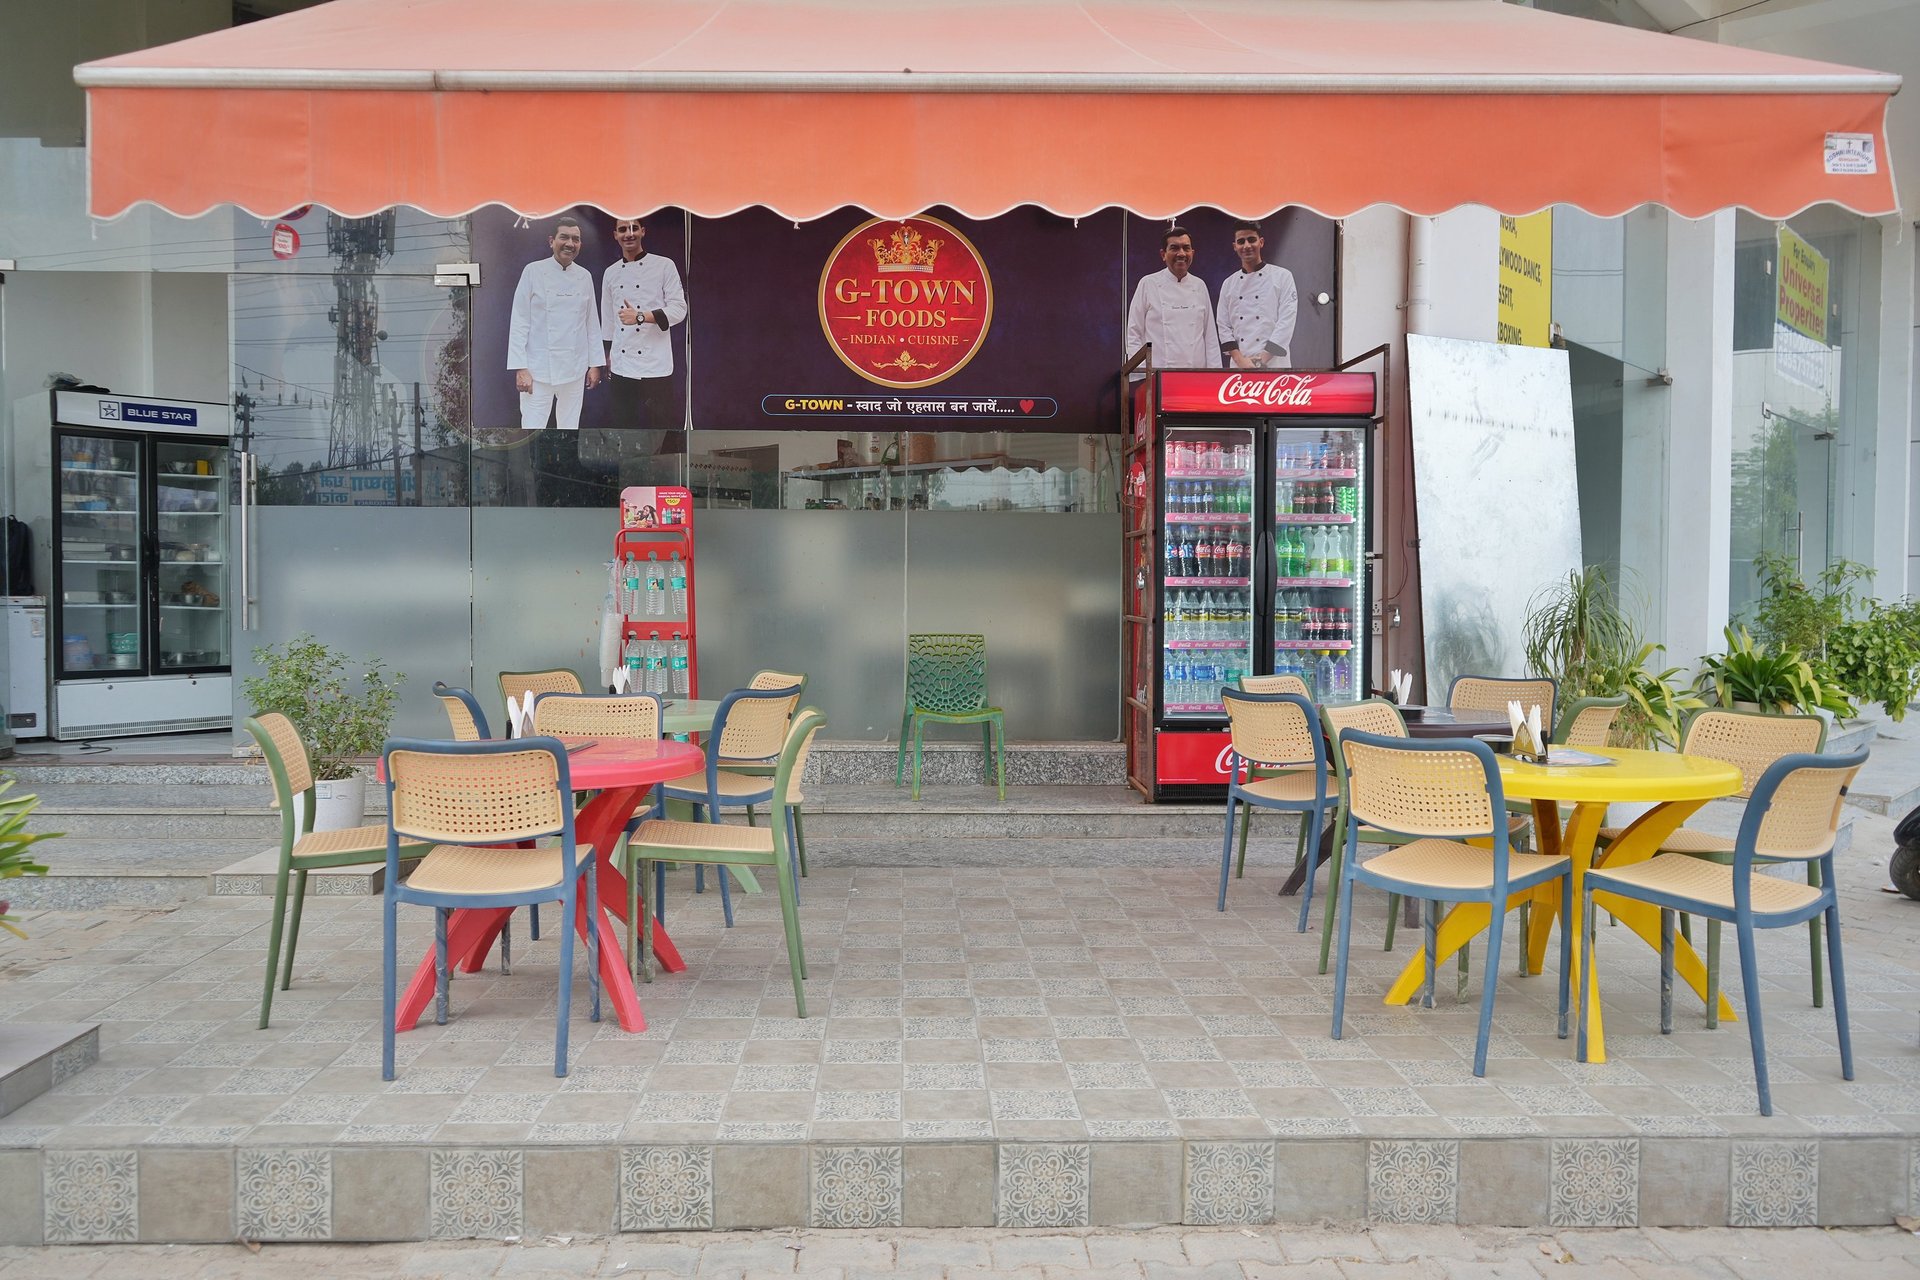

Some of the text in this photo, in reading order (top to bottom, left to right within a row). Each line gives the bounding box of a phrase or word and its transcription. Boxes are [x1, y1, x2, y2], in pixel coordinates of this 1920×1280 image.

[1523, 257, 1543, 287] DANCE,
[1782, 256, 1824, 309] Universal
[835, 278, 976, 305] G-TOWN
[866, 309, 946, 328] FOODS
[1779, 285, 1824, 337] Properties
[850, 334, 959, 346] INDIAN CUISINE
[1217, 373, 1317, 406] Coca-Cola
[127, 408, 192, 421] BLUE STAR
[784, 399, 843, 411] G-TOWN
[855, 400, 882, 413] स्वाद
[886, 398, 902, 413] जो
[906, 401, 946, 414] एहसास
[950, 401, 968, 413] बन
